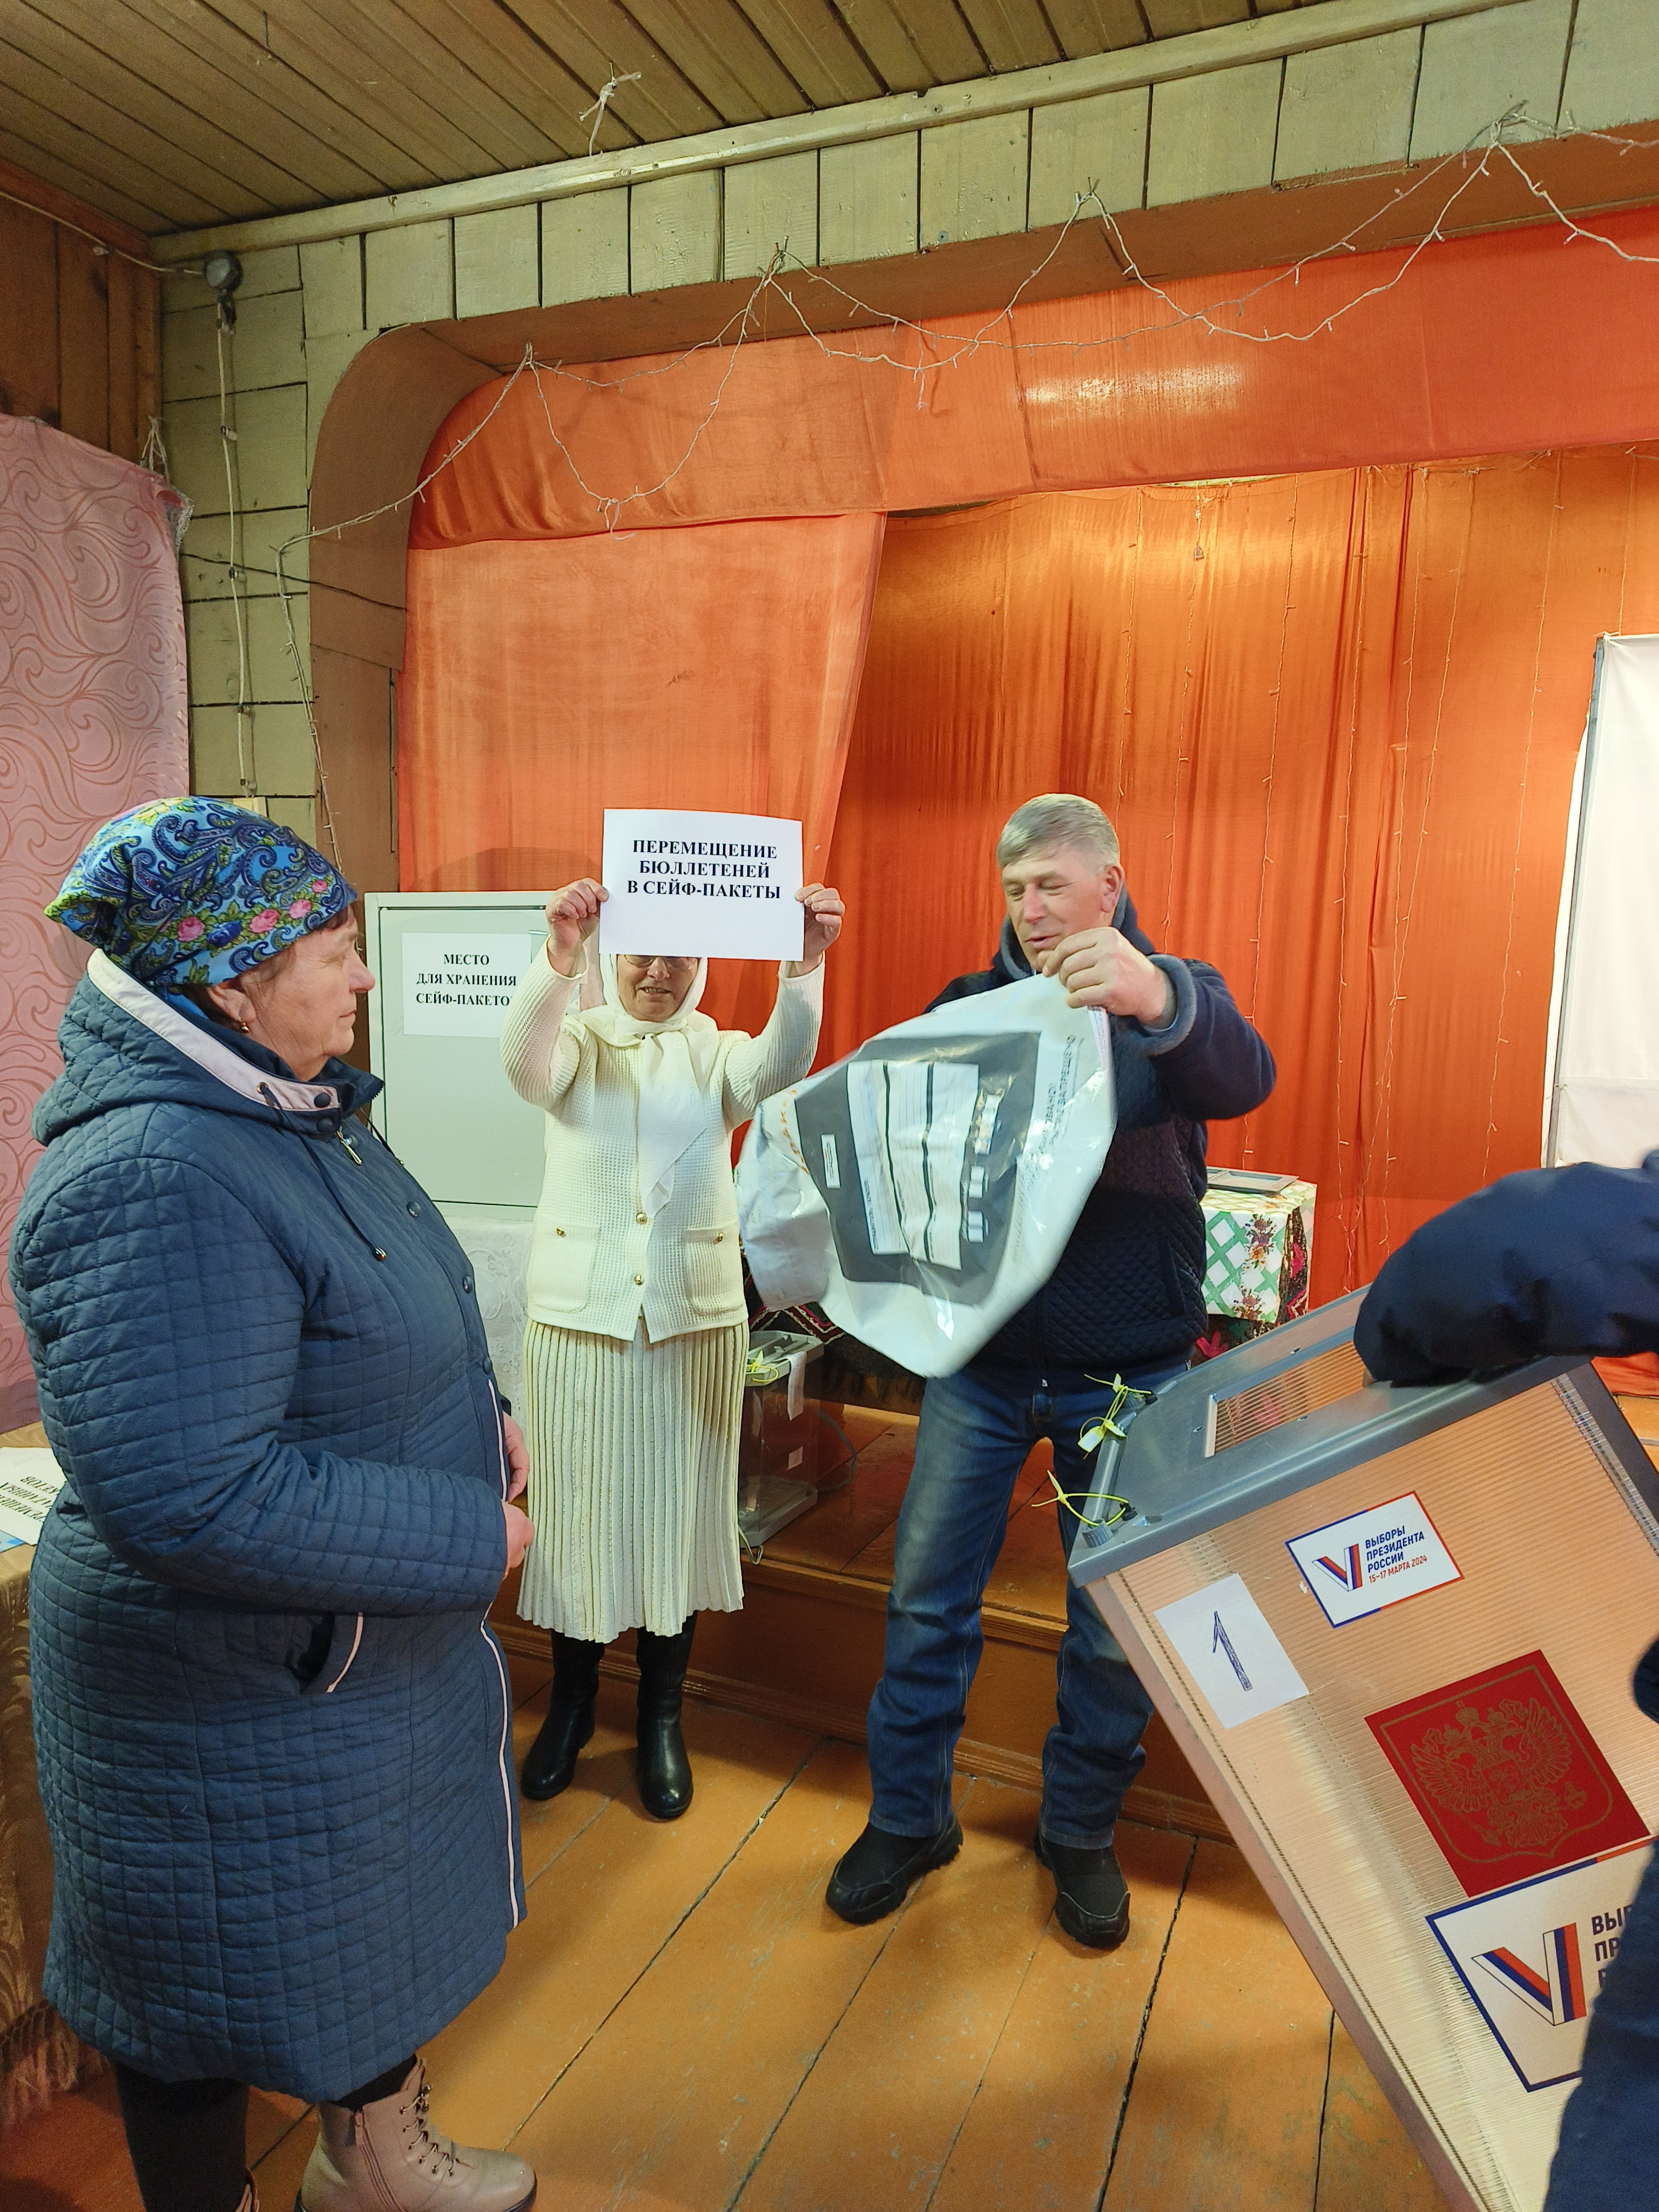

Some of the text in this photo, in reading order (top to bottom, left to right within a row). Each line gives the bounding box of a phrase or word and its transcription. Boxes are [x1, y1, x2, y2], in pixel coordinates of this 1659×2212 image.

[633, 840, 777, 859] ПЕРЕМЕЩЕНИЕ
[639, 860, 770, 878] БЮЛЛЕТЕНЕЙ
[627, 879, 780, 899] В СЕЙФ-ПАКЕТЫ
[443, 954, 490, 966] МЕСТО
[416, 973, 516, 986] ДЛЯ ХРАНЕНИЯ
[416, 992, 512, 1006] СЕЙФ-ПАКЕТО
[1365, 1525, 1405, 1549] ВЫБОРЫ
[1366, 1531, 1425, 1561] ПРЕЗИДЕНТА
[1368, 1551, 1404, 1573] РОССИИ
[1388, 1561, 1411, 1576] МАРТА
[1411, 1555, 1427, 1567] 2024
[1212, 1610, 1253, 1692] 1
